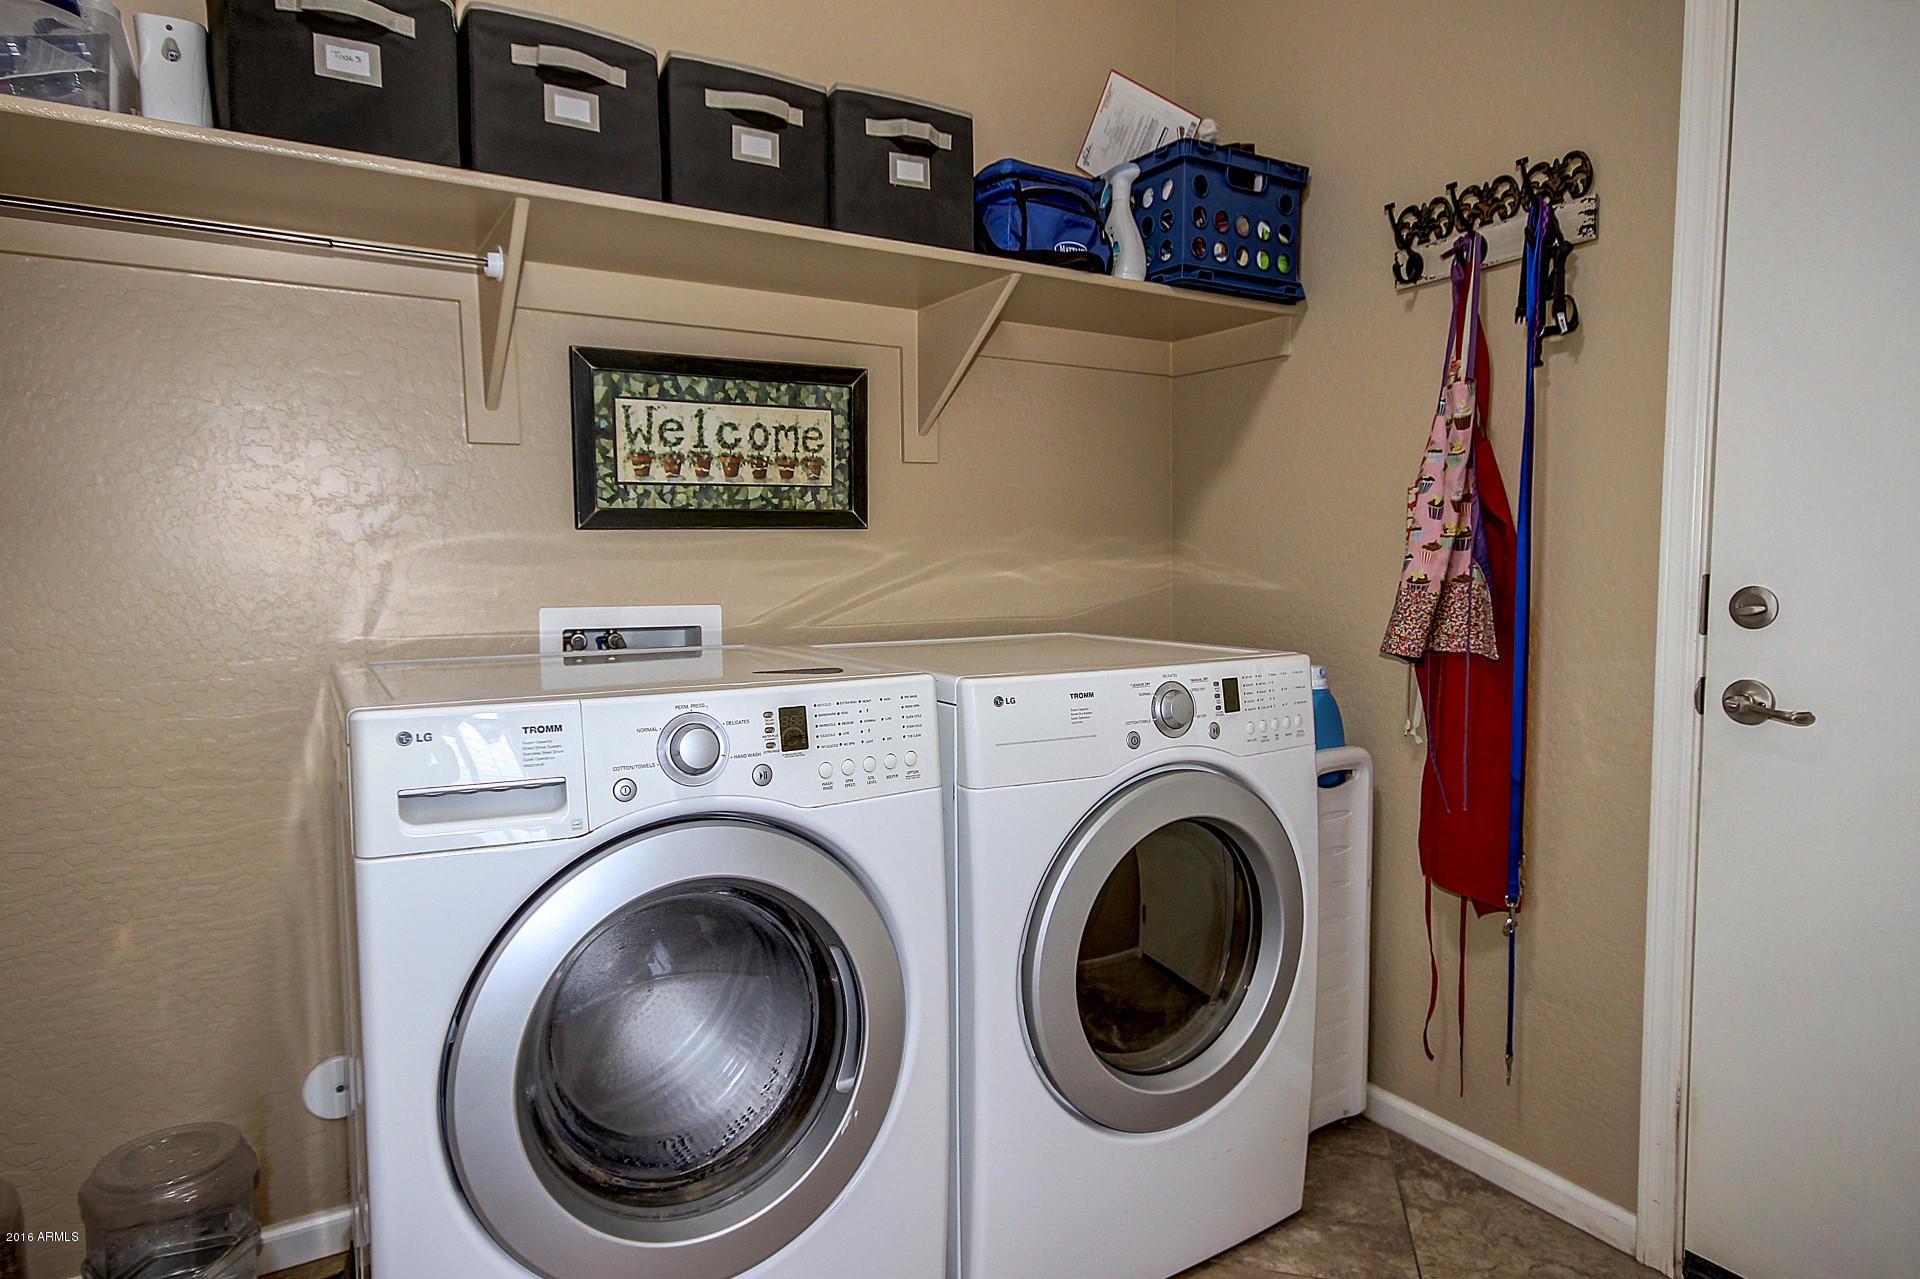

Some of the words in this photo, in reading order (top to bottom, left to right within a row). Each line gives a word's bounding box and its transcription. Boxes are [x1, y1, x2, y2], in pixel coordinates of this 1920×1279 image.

[621, 404, 825, 453] Welcome
[1069, 691, 1095, 700] TROMM
[1005, 697, 1016, 705] LG
[521, 724, 563, 734] TROMM
[416, 732, 433, 743] LG
[612, 763, 656, 772] COTTON/TOWELS
